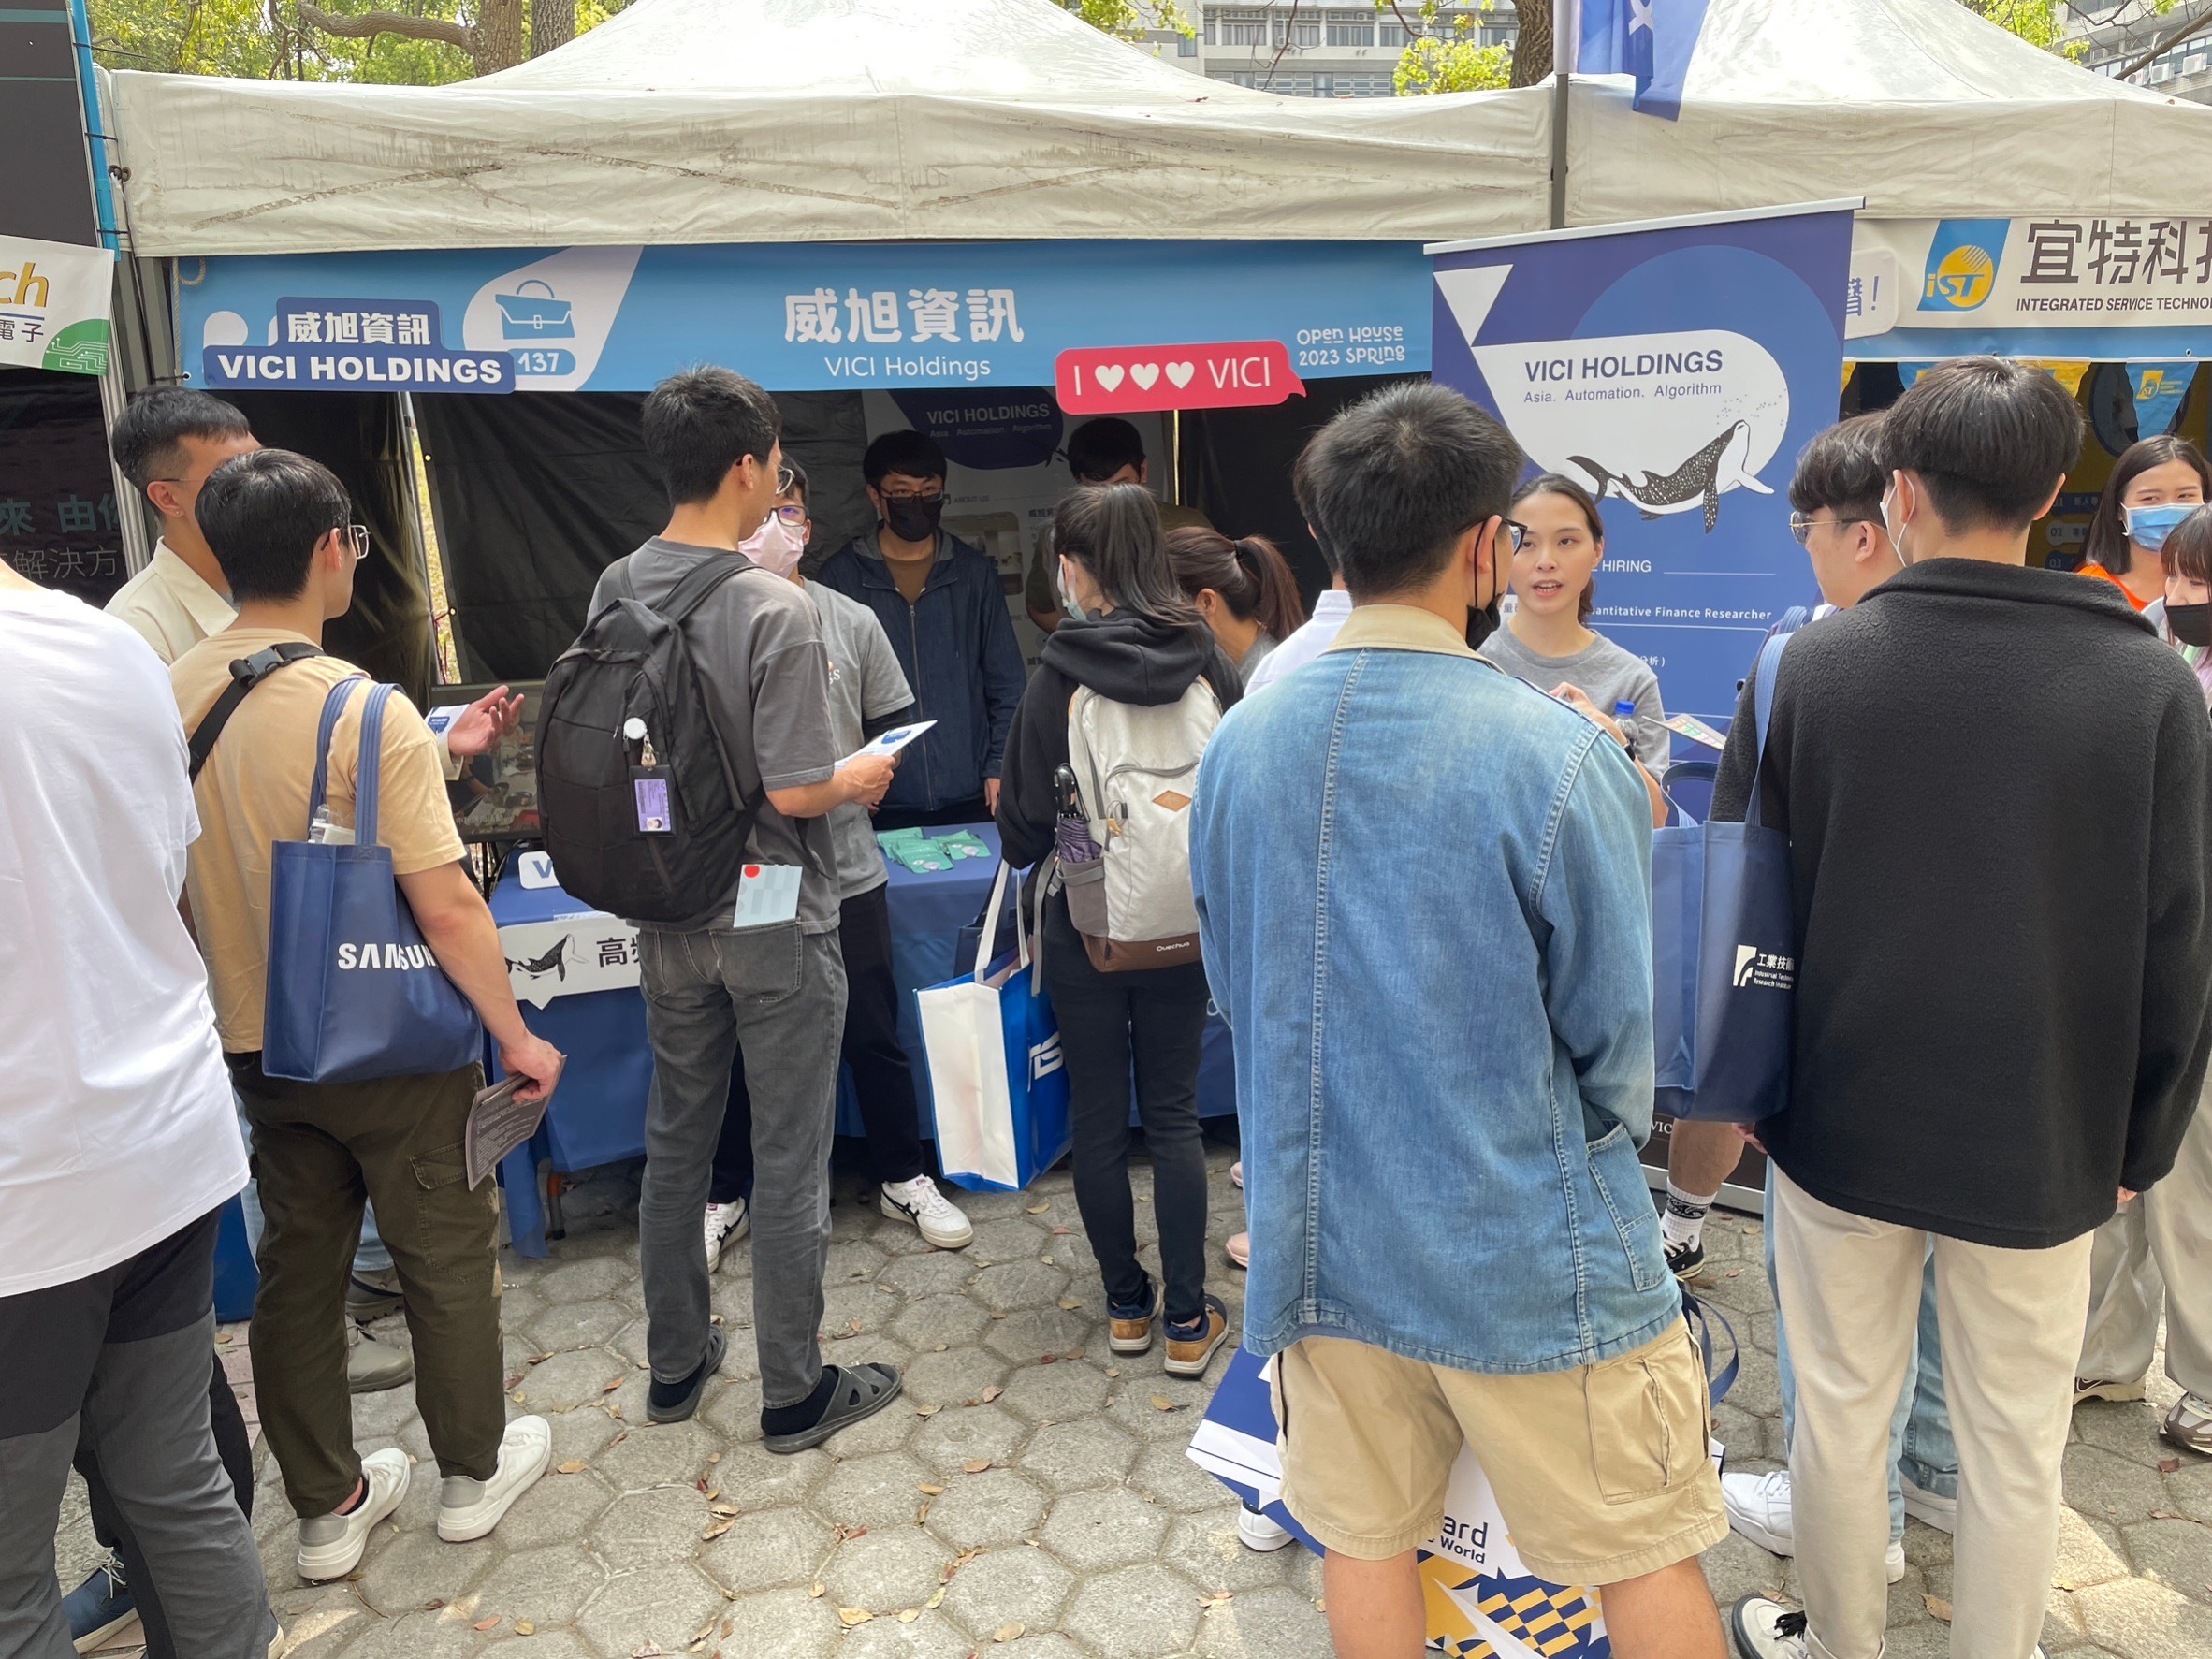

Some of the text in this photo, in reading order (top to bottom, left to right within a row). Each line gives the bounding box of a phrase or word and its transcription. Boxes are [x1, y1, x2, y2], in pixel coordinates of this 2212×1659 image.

[784, 287, 1025, 344] 威旭資訊
[2016, 298, 2103, 312] INTEGRATED
[2105, 298, 2153, 311] SERVICE
[287, 311, 431, 346] 威旭資訊
[217, 354, 502, 384] VICI HOLDINGS
[517, 352, 560, 372] 137
[824, 356, 992, 381] VICI Holdings
[1299, 349, 1340, 366] 2023
[1524, 349, 1724, 383] VICI HOLDINGS
[1073, 357, 1271, 396] I VICI
[1523, 383, 1722, 403] Asia. Automation. Algorithm
[926, 403, 1051, 424] VICI HOLDINGS
[1602, 560, 1652, 573] HIRING
[1592, 606, 1772, 619] antitative Finance Researcher
[338, 943, 438, 970] SAMSUN
[1442, 1516, 1488, 1549] ard
[1440, 1535, 1486, 1564] World
